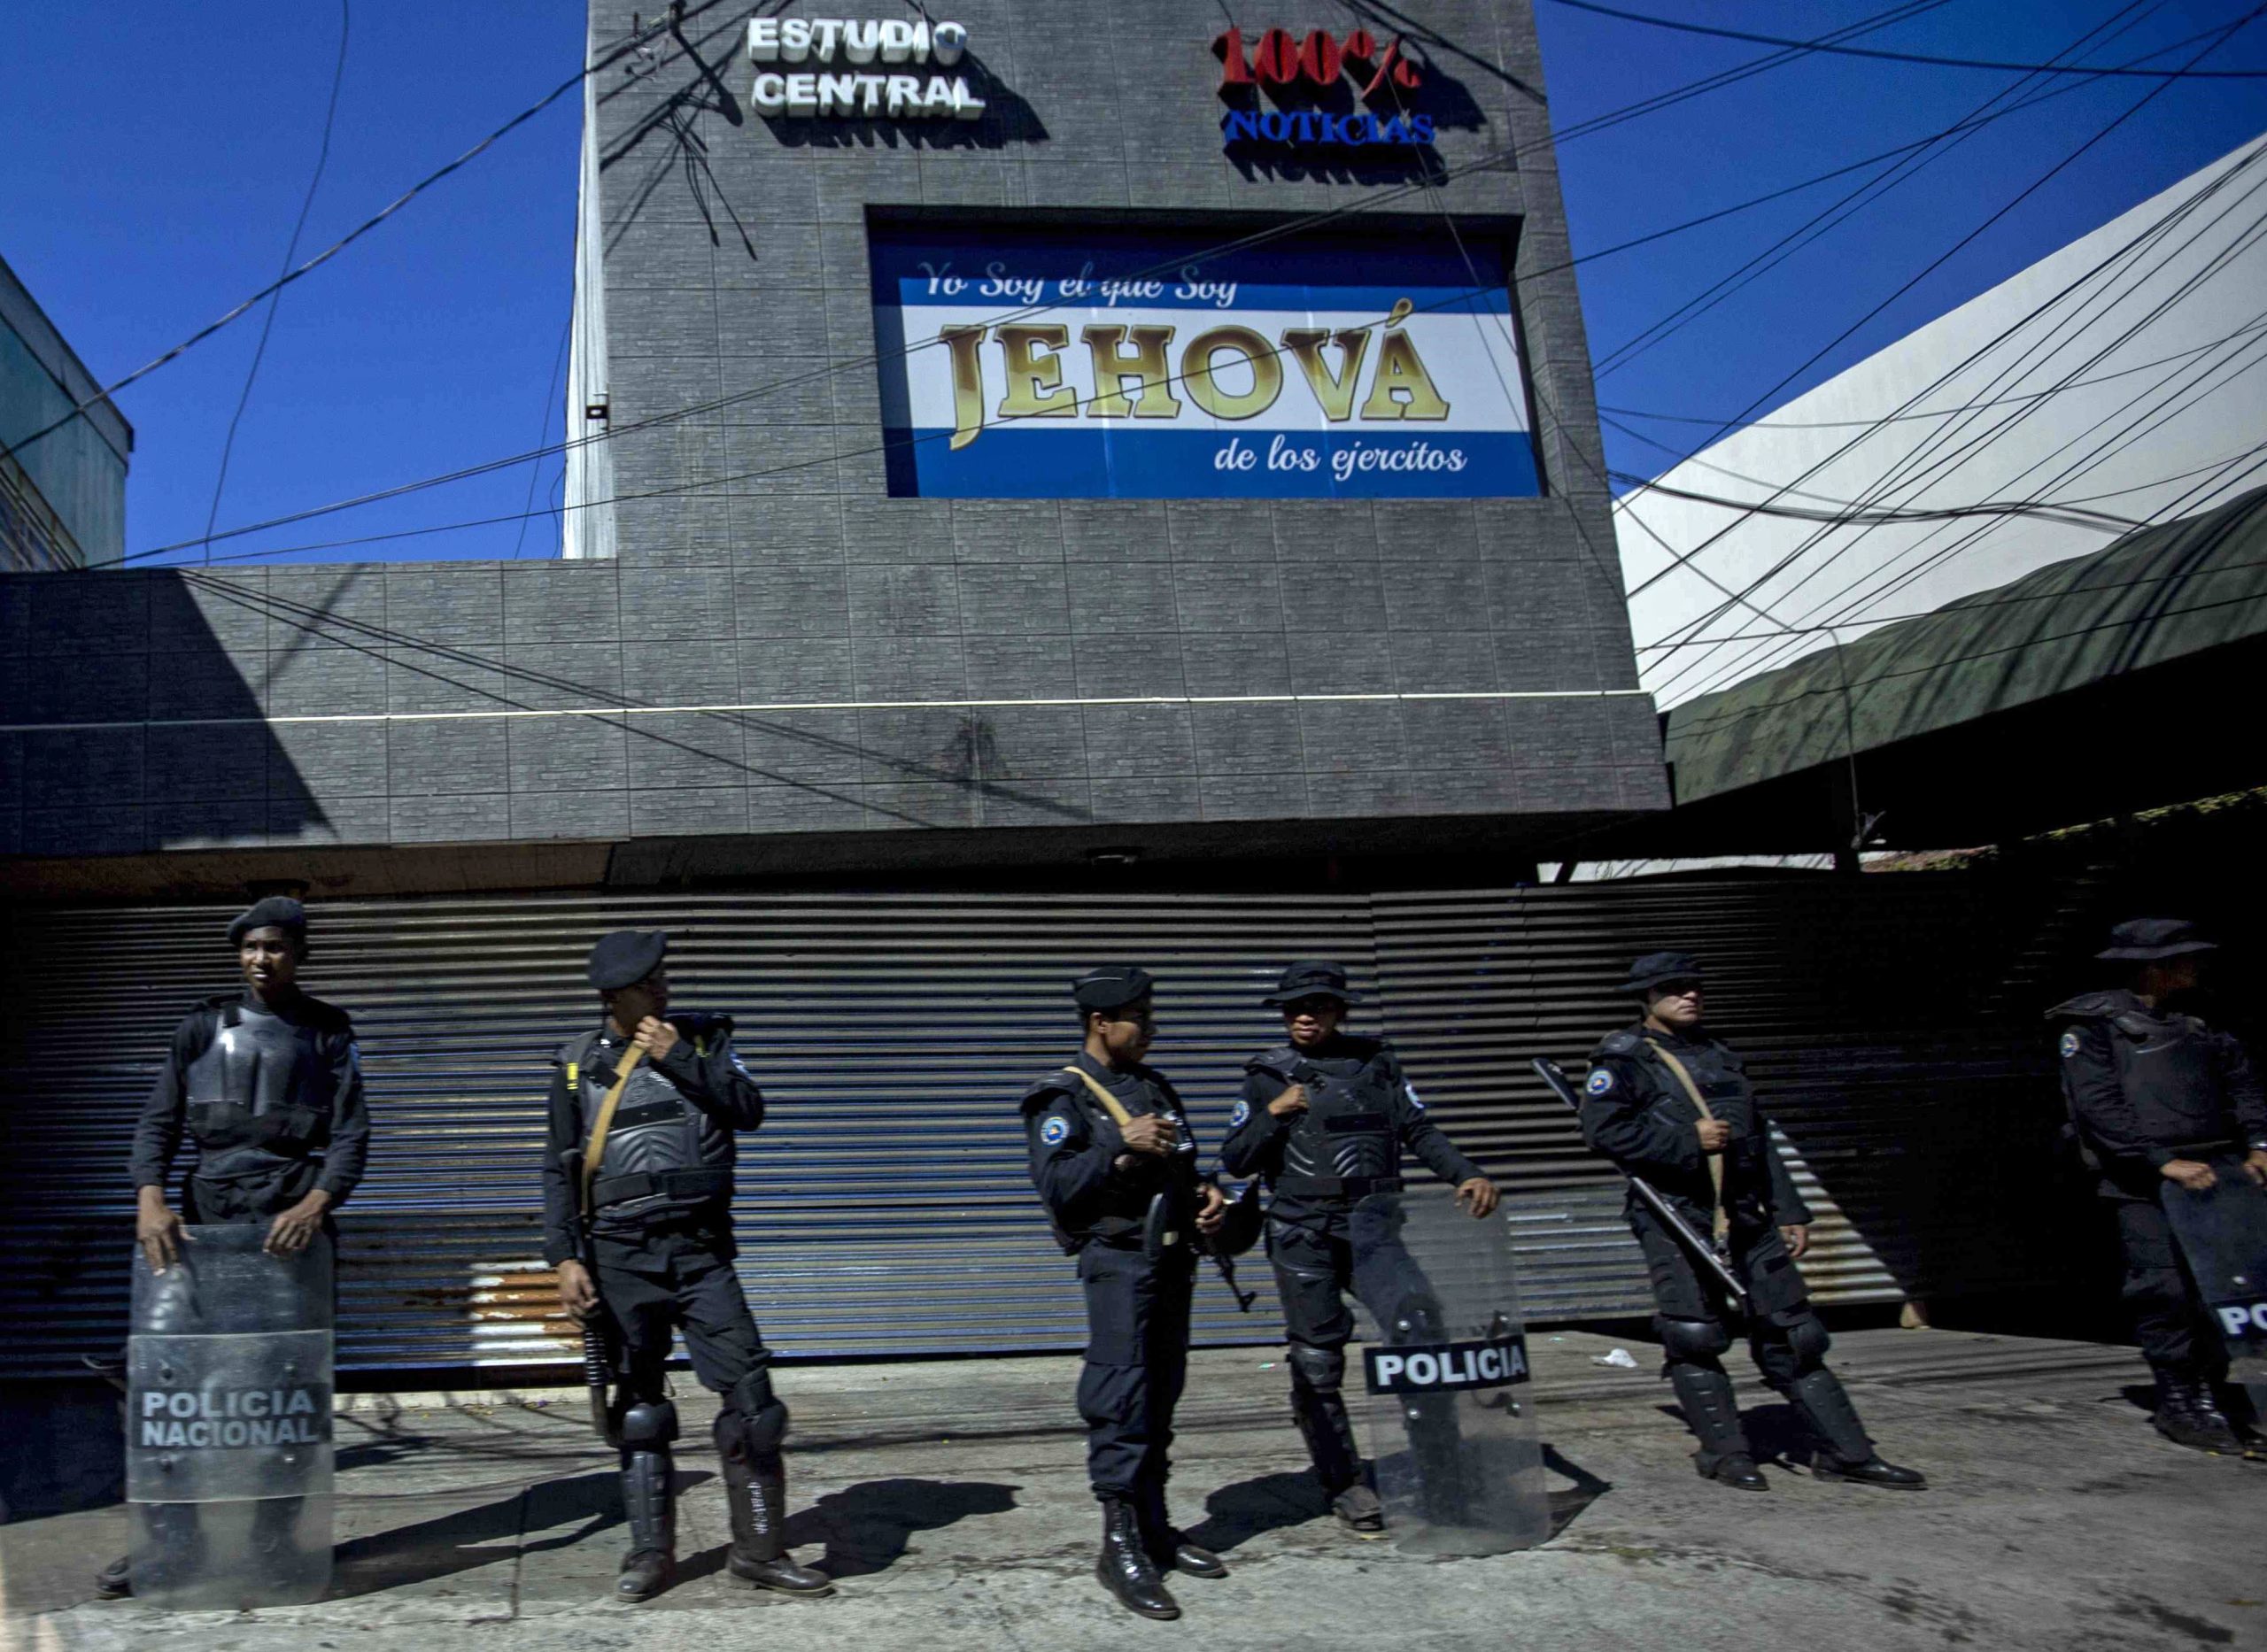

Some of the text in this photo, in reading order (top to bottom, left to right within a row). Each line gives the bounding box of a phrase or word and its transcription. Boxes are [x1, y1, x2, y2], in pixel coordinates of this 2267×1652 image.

[747, 18, 967, 66] ESTUDIO
[1211, 27, 1422, 100] 100%
[752, 73, 986, 120] CENTRAL
[1220, 109, 1435, 146] NOTICIAS
[917, 261, 1239, 309] Yo Soy el que Soy
[939, 297, 1451, 452] JEHOVÁ
[1213, 434, 1467, 482] de los ejercitos
[1374, 1345, 1527, 1386] POLICIA
[142, 1389, 318, 1418] POLICIA
[142, 1417, 321, 1447] NACIONAL
